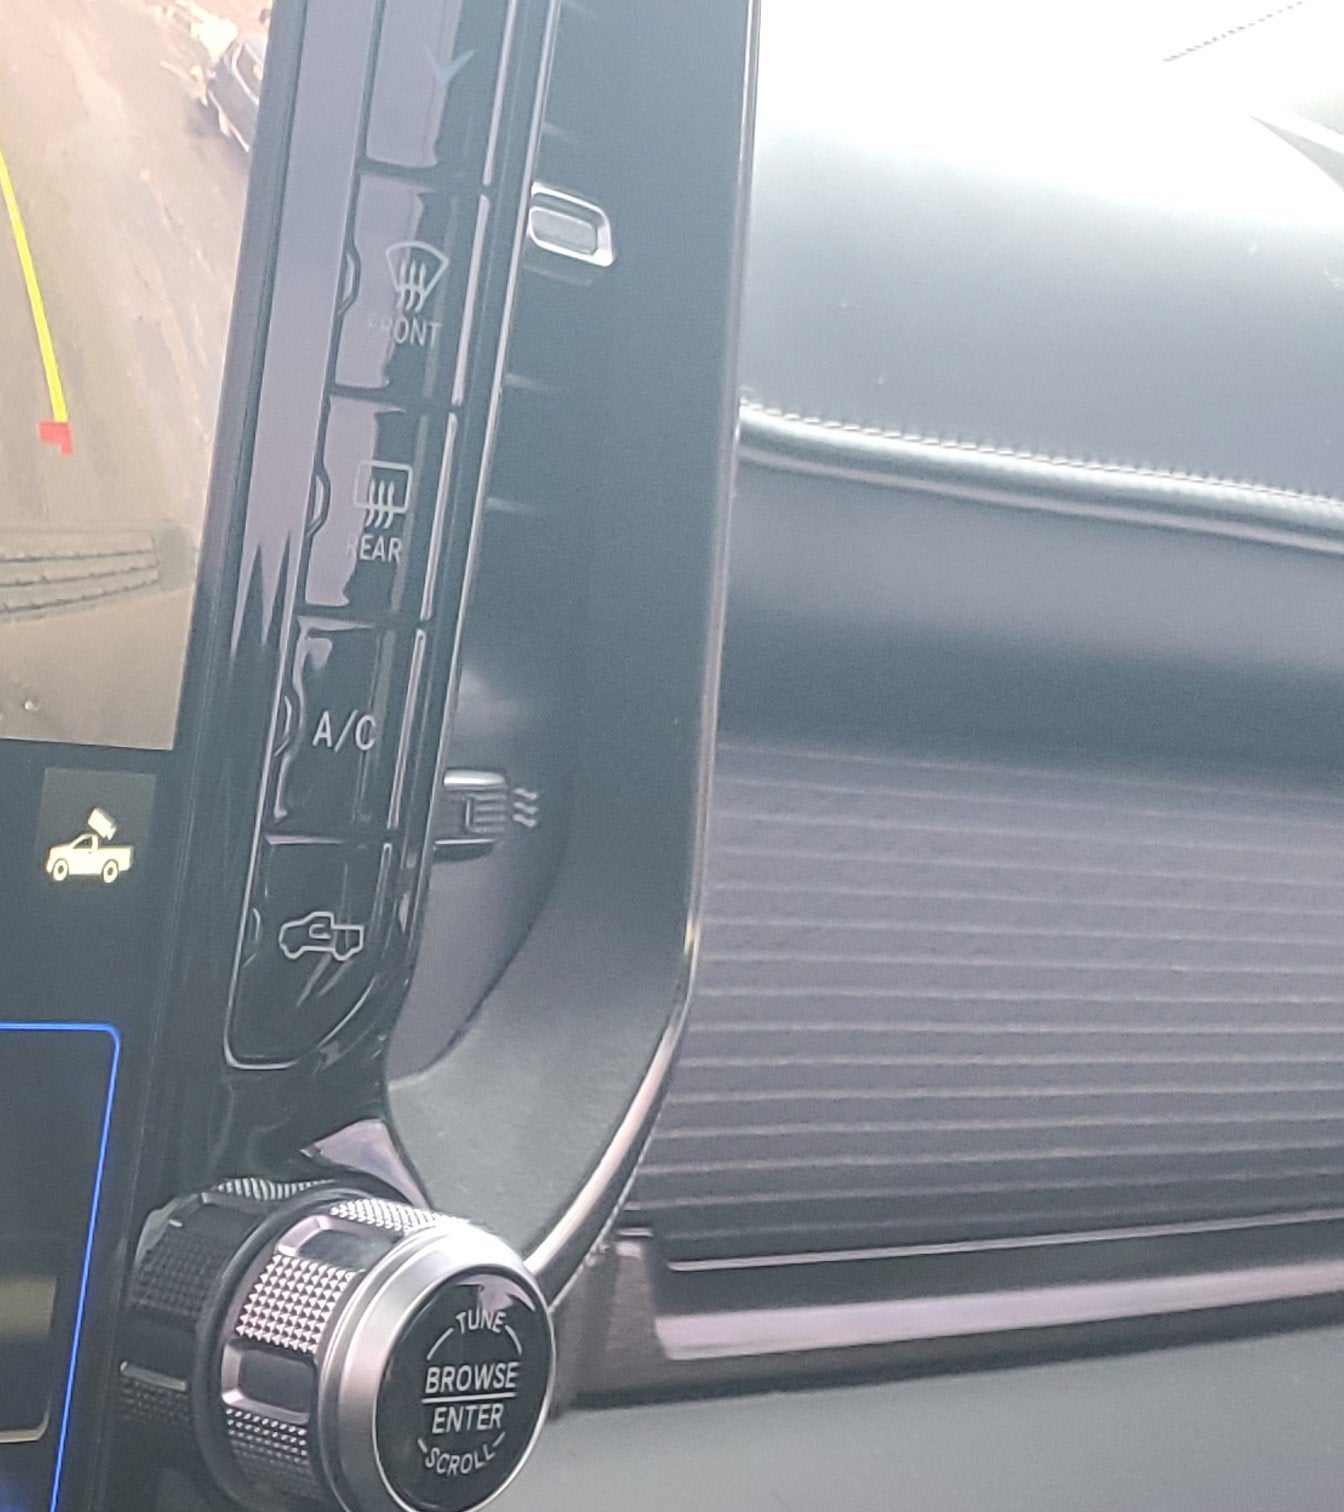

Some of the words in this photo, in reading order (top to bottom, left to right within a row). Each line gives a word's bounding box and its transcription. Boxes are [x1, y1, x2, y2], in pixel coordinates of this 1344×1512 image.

[312, 710, 376, 753] A/C
[457, 1309, 504, 1334] TUNE
[425, 1362, 518, 1394] BROWSE
[432, 1404, 503, 1434] ENTER
[425, 1445, 496, 1475] SCROLL
